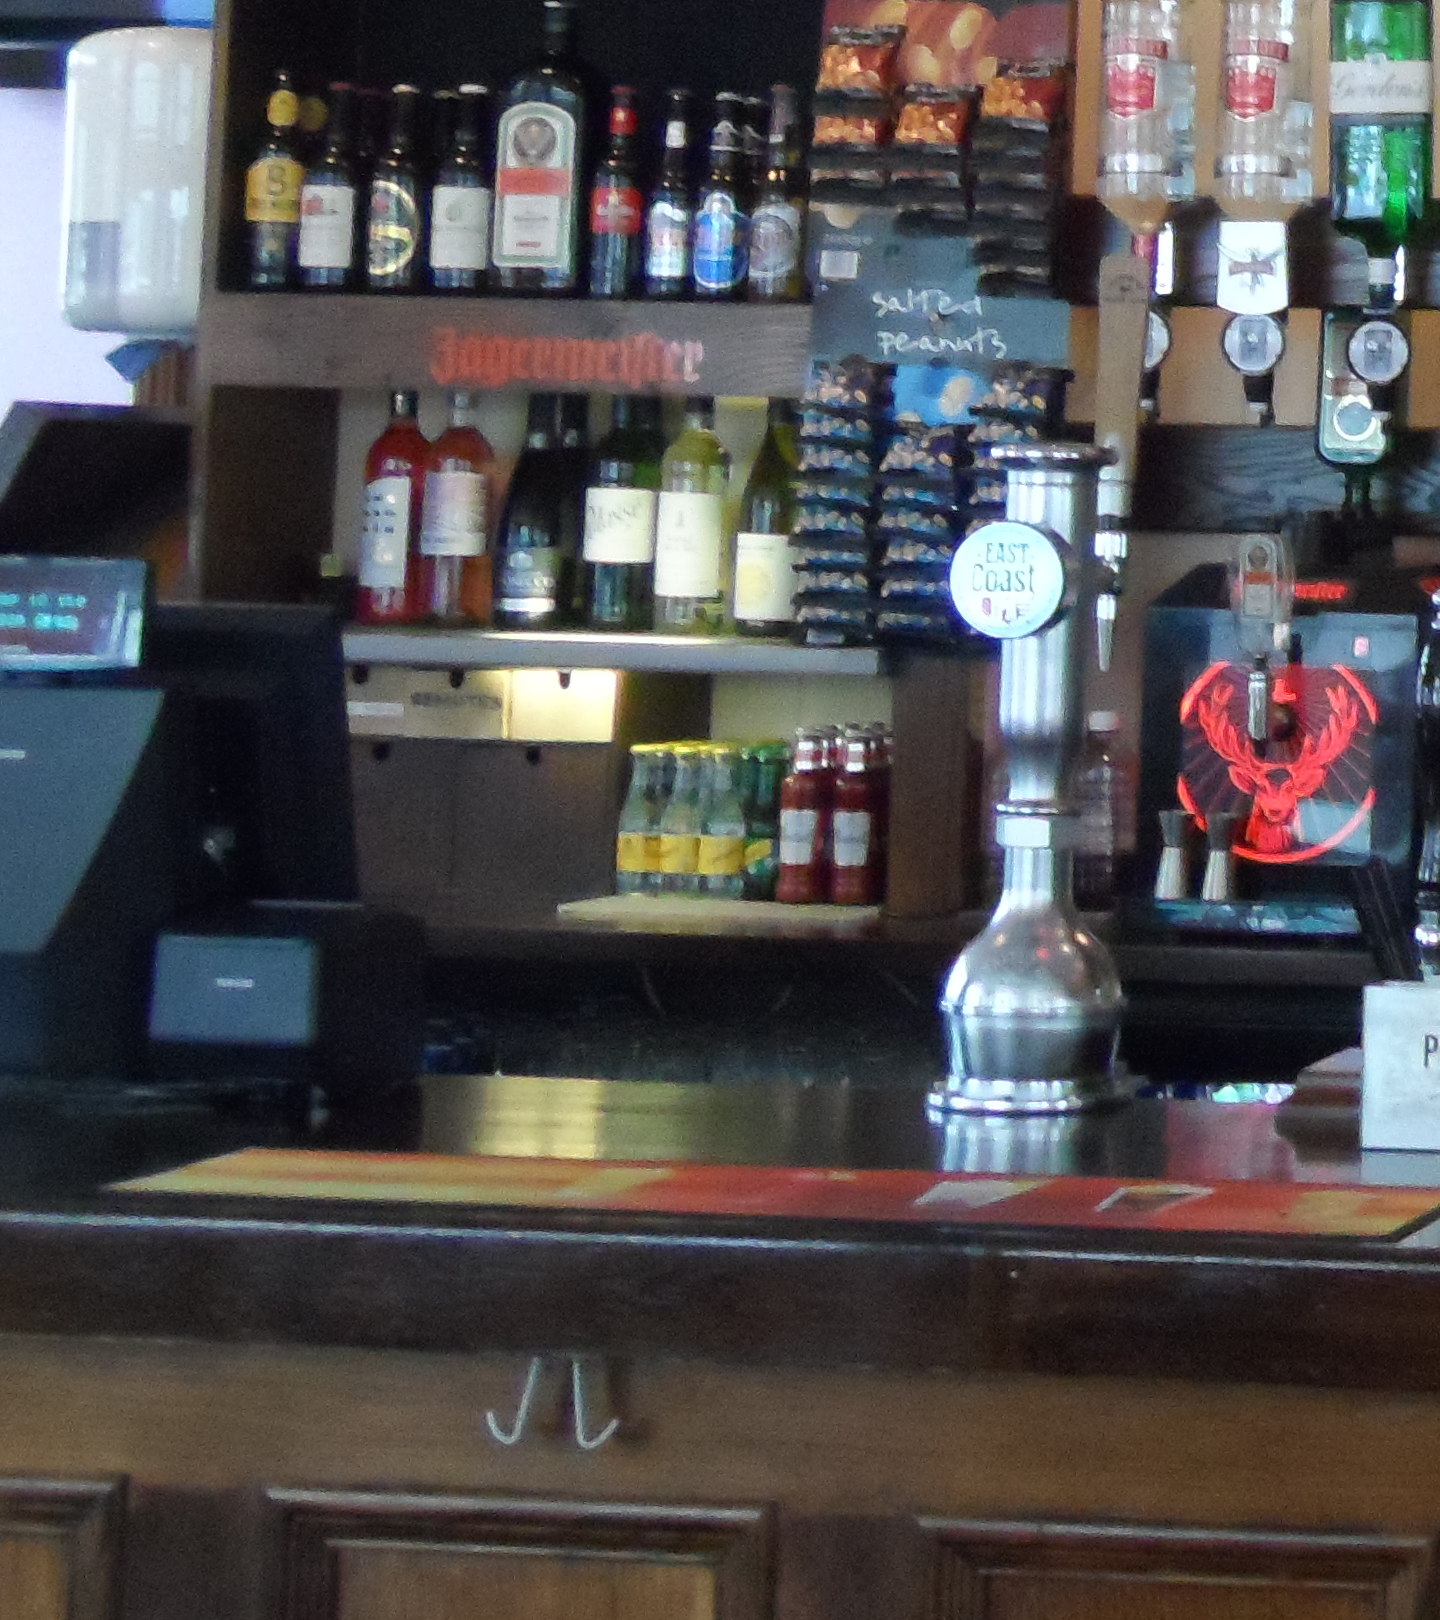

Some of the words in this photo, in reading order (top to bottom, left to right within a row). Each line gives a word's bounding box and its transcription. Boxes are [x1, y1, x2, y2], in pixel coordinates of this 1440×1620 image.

[872, 286, 983, 317] salted
[878, 329, 1007, 359] peanuts
[985, 542, 1030, 564] EAST
